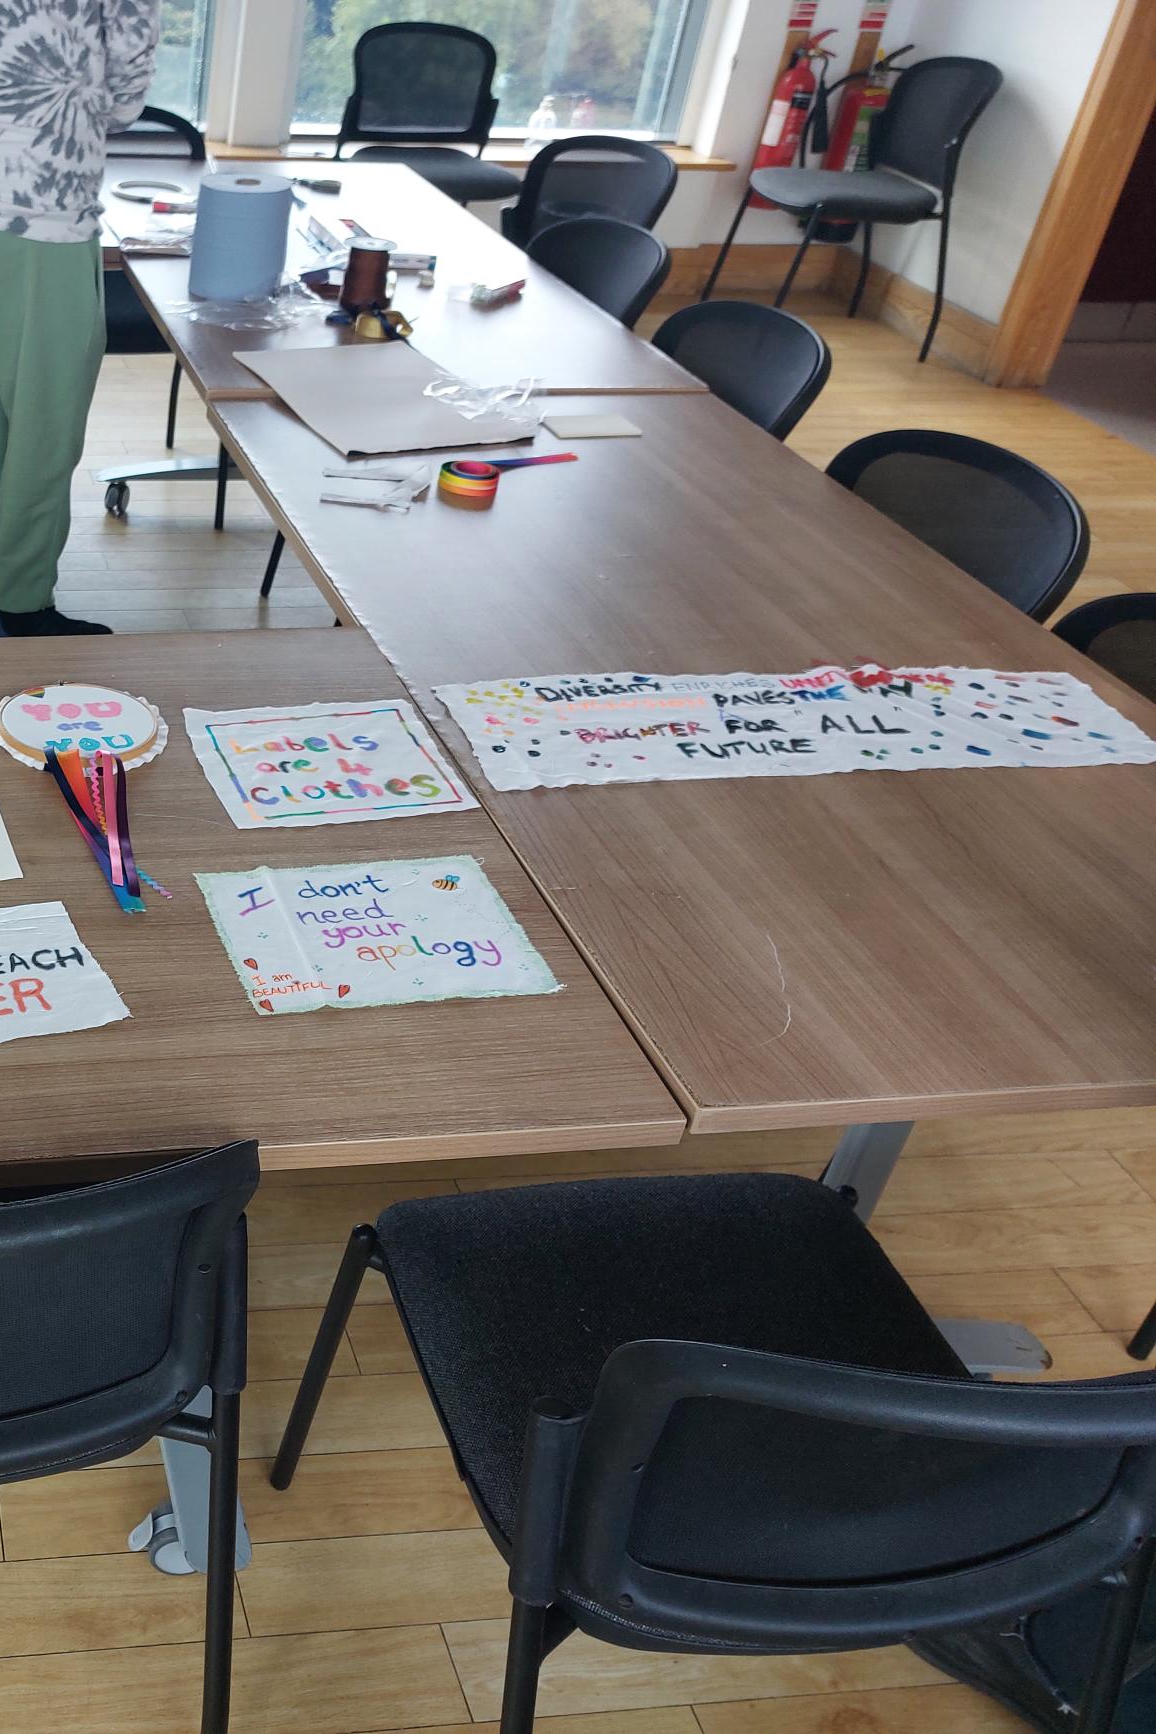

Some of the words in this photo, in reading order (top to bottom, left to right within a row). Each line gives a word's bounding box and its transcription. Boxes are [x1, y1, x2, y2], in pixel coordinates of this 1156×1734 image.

[534, 681, 663, 702] DIVERSITY
[712, 689, 795, 708] PAVES
[20, 700, 123, 722] YOU
[44, 733, 134, 752] YOU
[574, 720, 711, 744] BRIGHTER
[724, 718, 788, 735] FOR
[228, 733, 380, 756] Labels
[676, 737, 817, 760] FUTURE
[255, 758, 320, 774] are
[335, 757, 373, 777] 4
[238, 885, 276, 917] I
[297, 873, 391, 900] don't
[295, 898, 394, 926] need
[321, 920, 407, 950] your
[356, 934, 503, 971] apology
[252, 974, 266, 987] I
[271, 972, 293, 983] am
